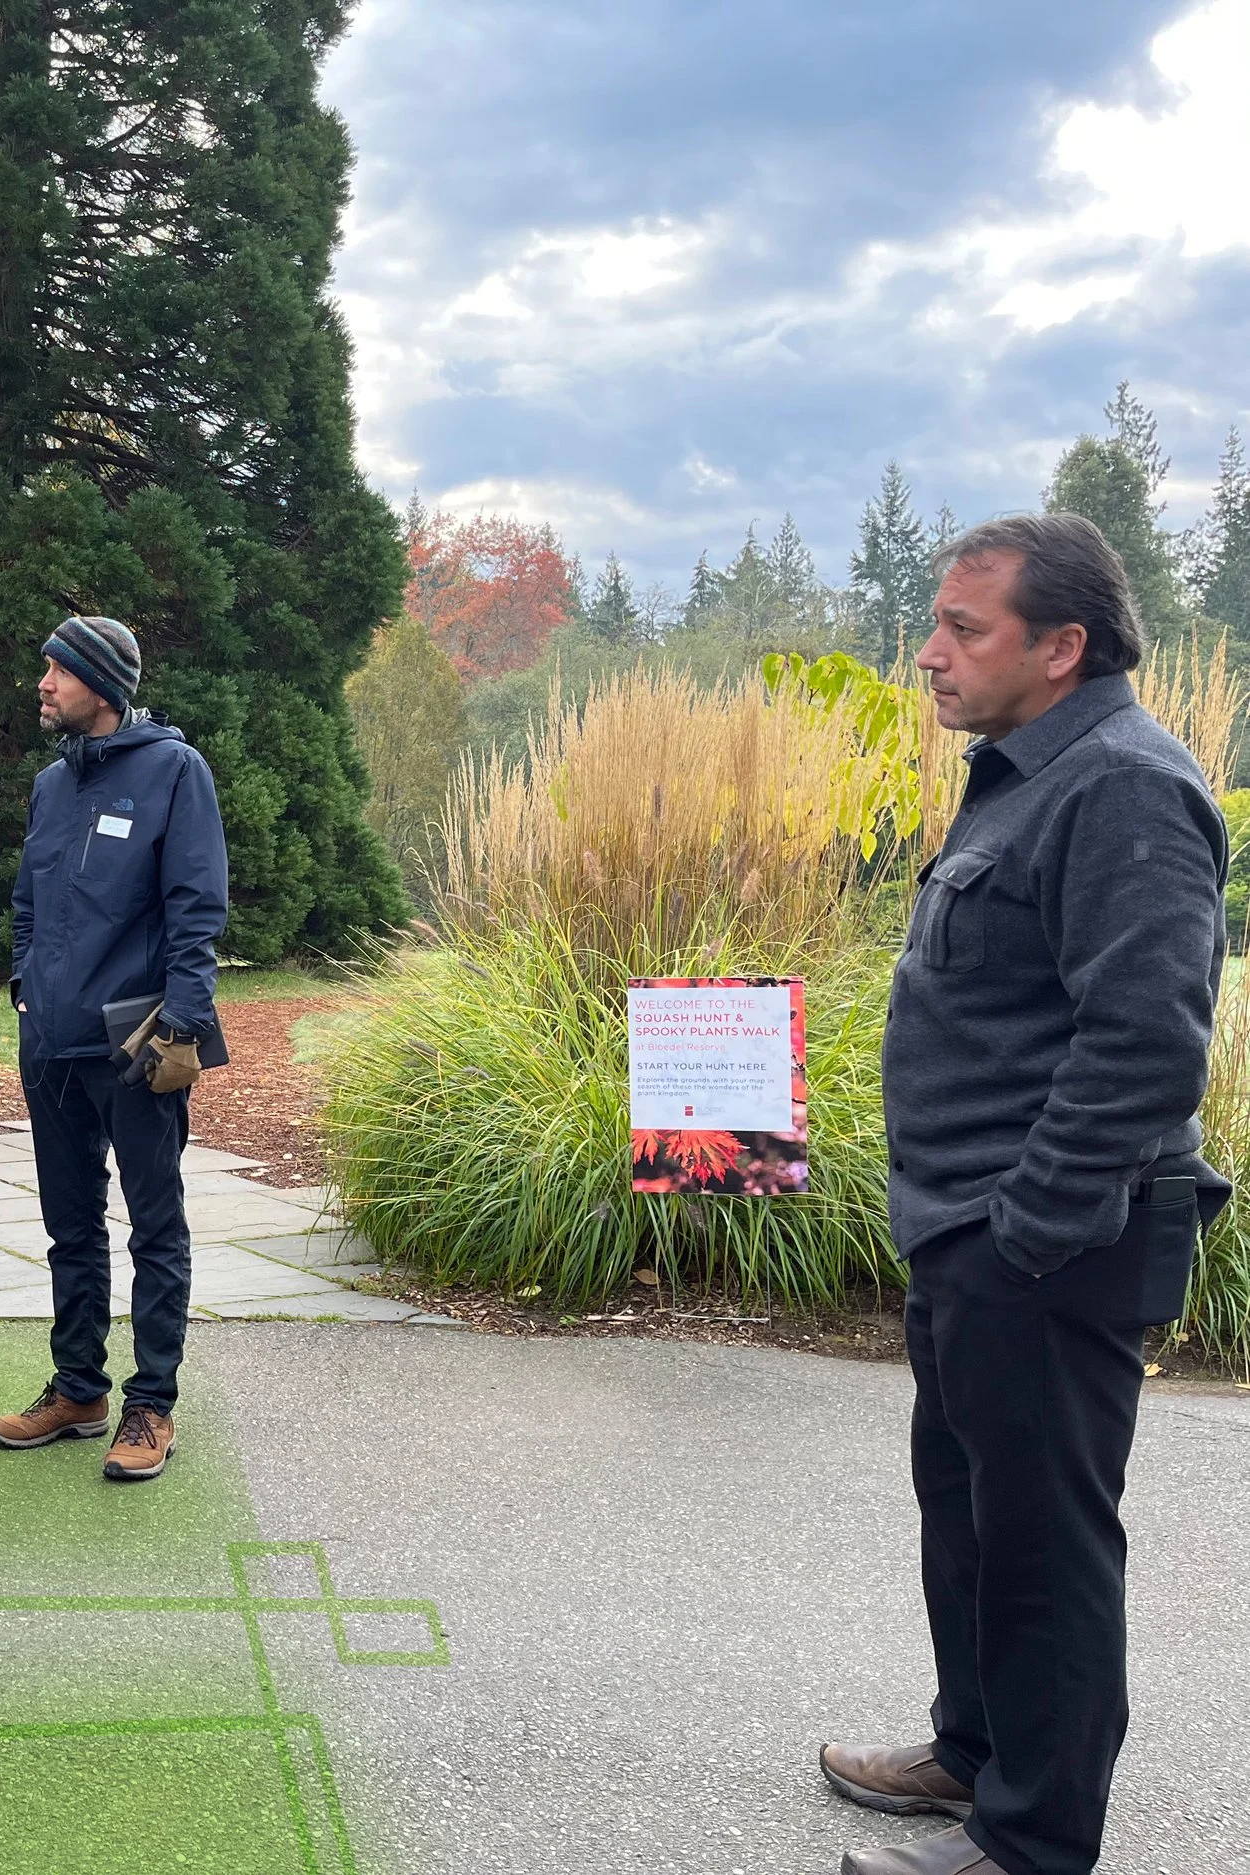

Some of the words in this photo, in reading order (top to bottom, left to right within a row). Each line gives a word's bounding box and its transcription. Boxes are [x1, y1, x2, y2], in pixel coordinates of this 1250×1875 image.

[635, 1000, 702, 1009] WELCOME
[709, 1000, 725, 1009] TO
[730, 1000, 755, 1009] THE
[635, 1014, 689, 1022] SQUASH
[695, 1014, 730, 1022] HUNT
[735, 1014, 744, 1022] &
[636, 1027, 686, 1036] SPOOKY
[690, 1027, 738, 1036] PLANTS
[742, 1027, 780, 1036] WALK
[648, 1043, 684, 1051] Bloedel
[687, 1043, 726, 1051] Reserve
[739, 1063, 767, 1071] HERE
